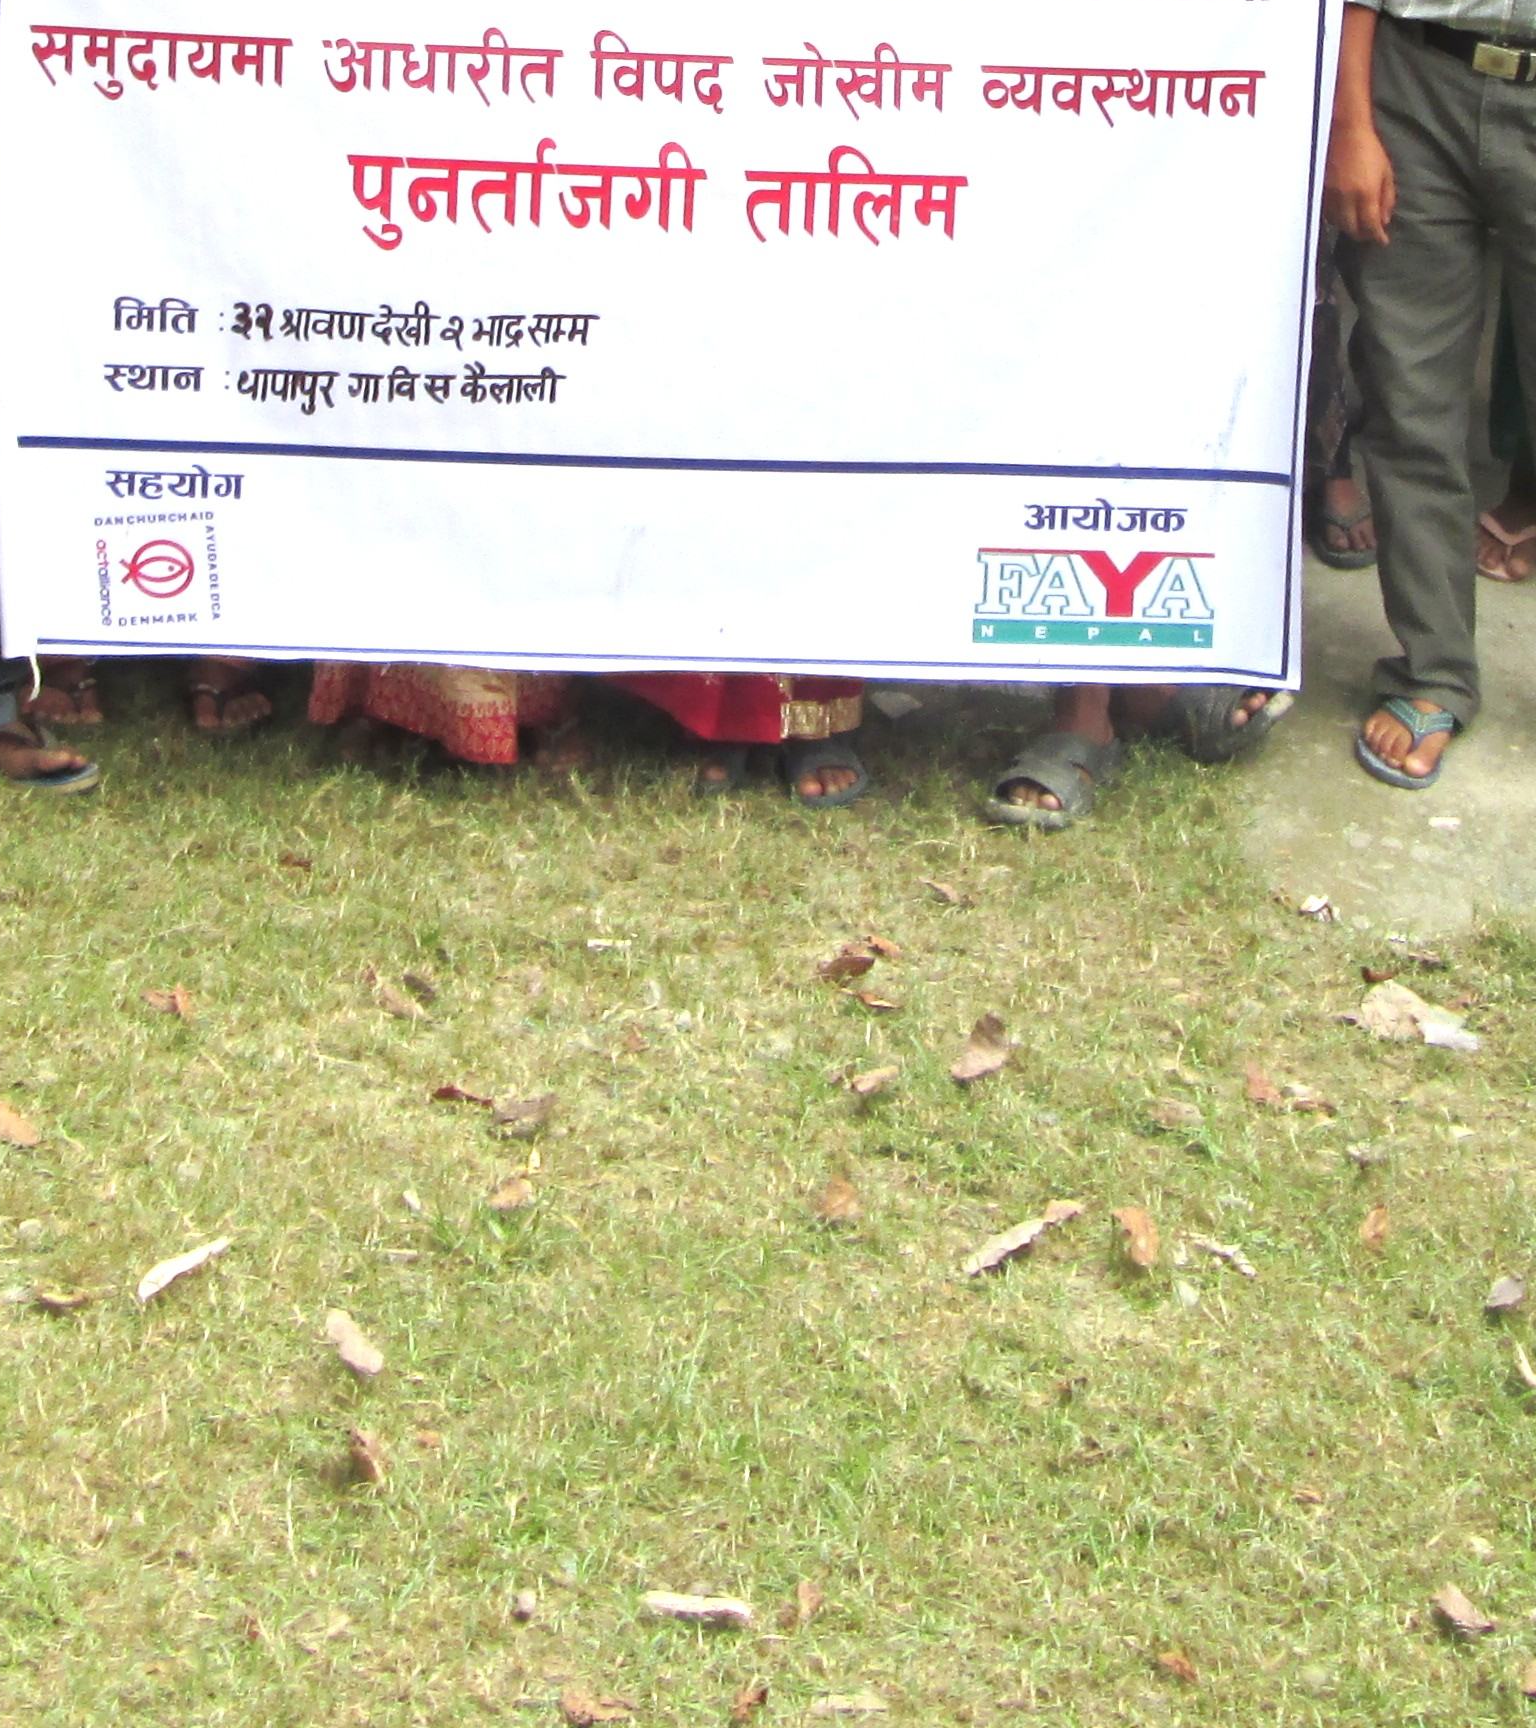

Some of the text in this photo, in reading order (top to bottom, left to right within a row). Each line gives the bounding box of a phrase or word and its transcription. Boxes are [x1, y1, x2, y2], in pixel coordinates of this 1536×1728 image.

[30, 24, 1267, 128] समुदायमा आधारीत विपद जोखीम व्यवस्थापन
[347, 136, 968, 252] पुनर्ताजगी तालिम
[113, 295, 200, 334] मिति
[103, 363, 205, 393] स्थान
[460, 360, 568, 405] कैलाली
[105, 463, 245, 501] सहयोग
[1023, 497, 1190, 533] आयोजक
[973, 547, 1216, 620] FAYA
[117, 612, 199, 628] DENMARK
[980, 624, 1205, 643] NEPAL
